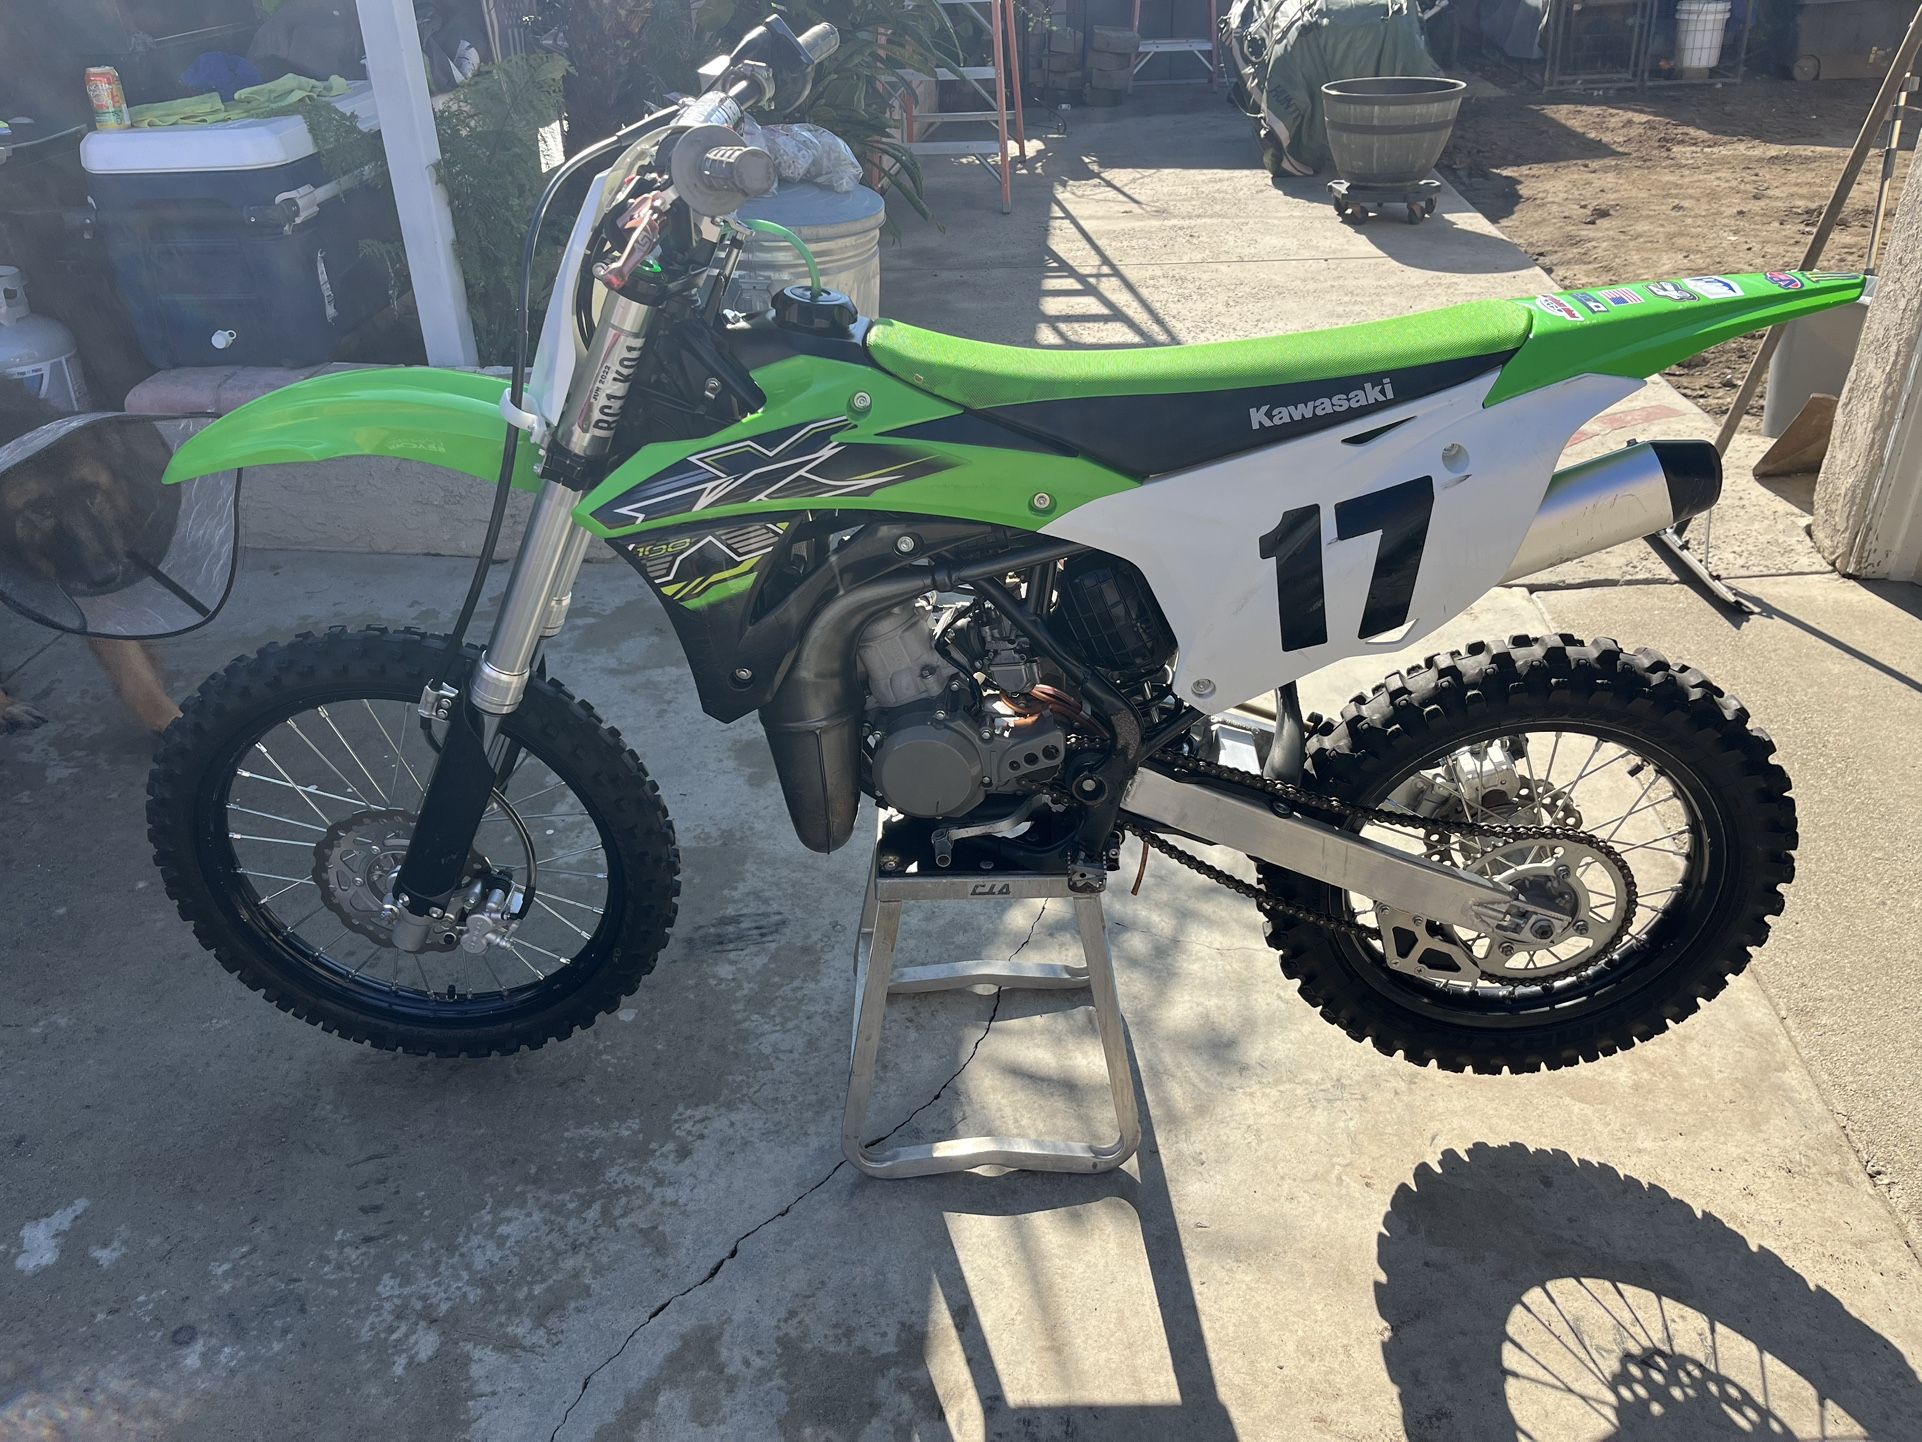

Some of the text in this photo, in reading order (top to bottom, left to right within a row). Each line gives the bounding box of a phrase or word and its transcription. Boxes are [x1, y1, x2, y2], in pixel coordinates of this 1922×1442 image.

[598, 364, 612, 385] 2022
[1249, 377, 1395, 430] Kawasaki
[1258, 474, 1435, 652] 17
